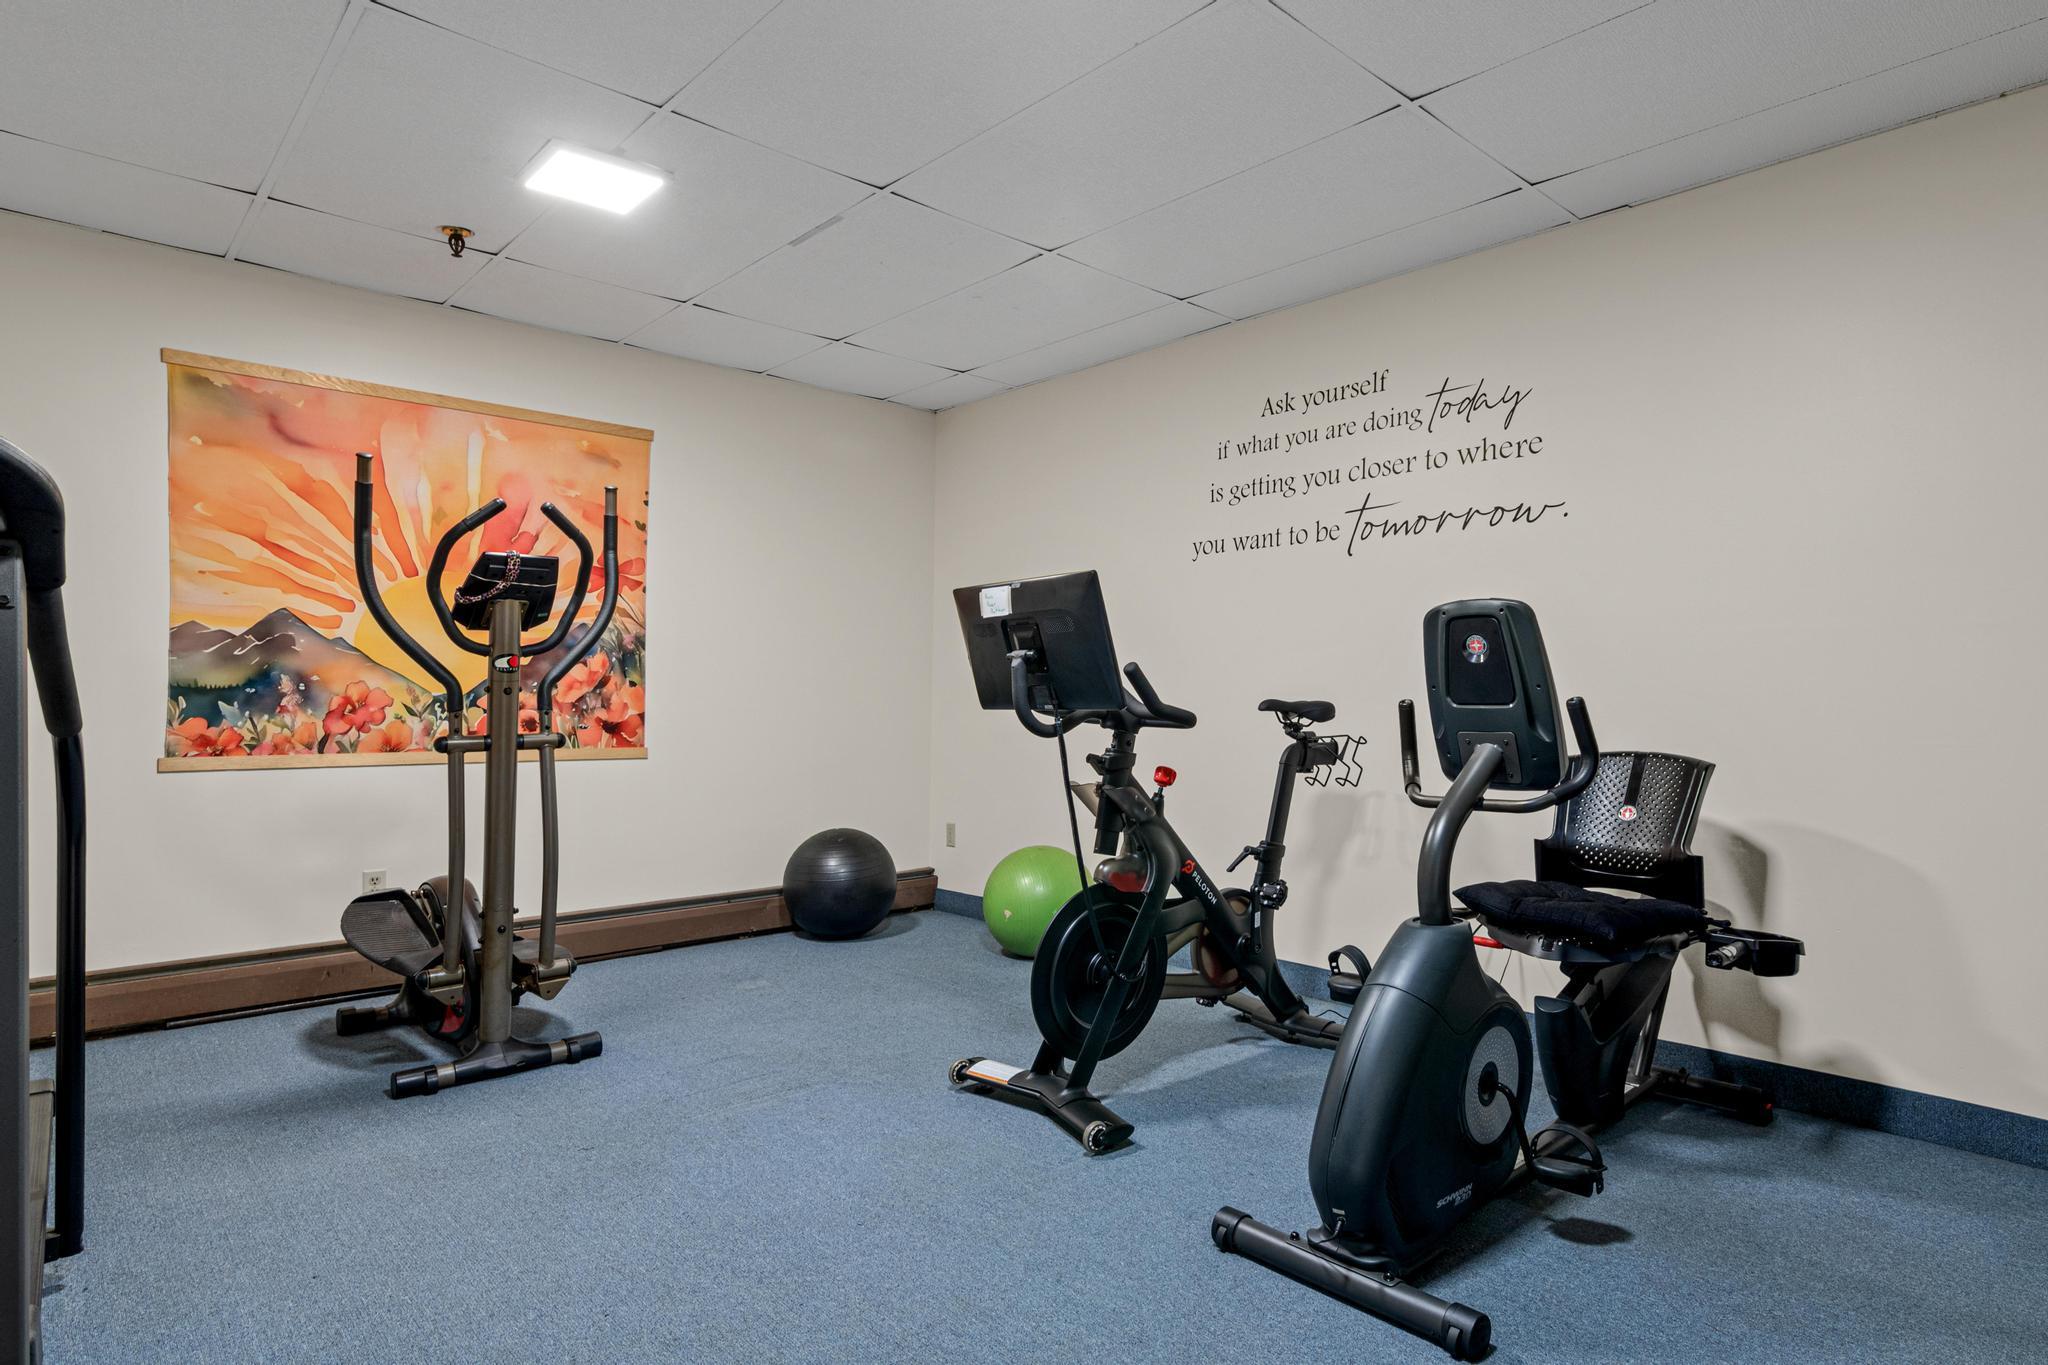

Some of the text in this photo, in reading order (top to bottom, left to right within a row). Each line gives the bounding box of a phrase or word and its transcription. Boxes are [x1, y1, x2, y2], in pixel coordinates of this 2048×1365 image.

[1218, 377, 1533, 460] if what you are doing today
[1260, 369, 1390, 418] Ask yourself
[1210, 436, 1544, 507] is getting you closer to where
[1191, 492, 1569, 562] you want to be tomorrow.
[1191, 870, 1218, 905] PELOTON
[1436, 1182, 1473, 1209] SCHWINN
